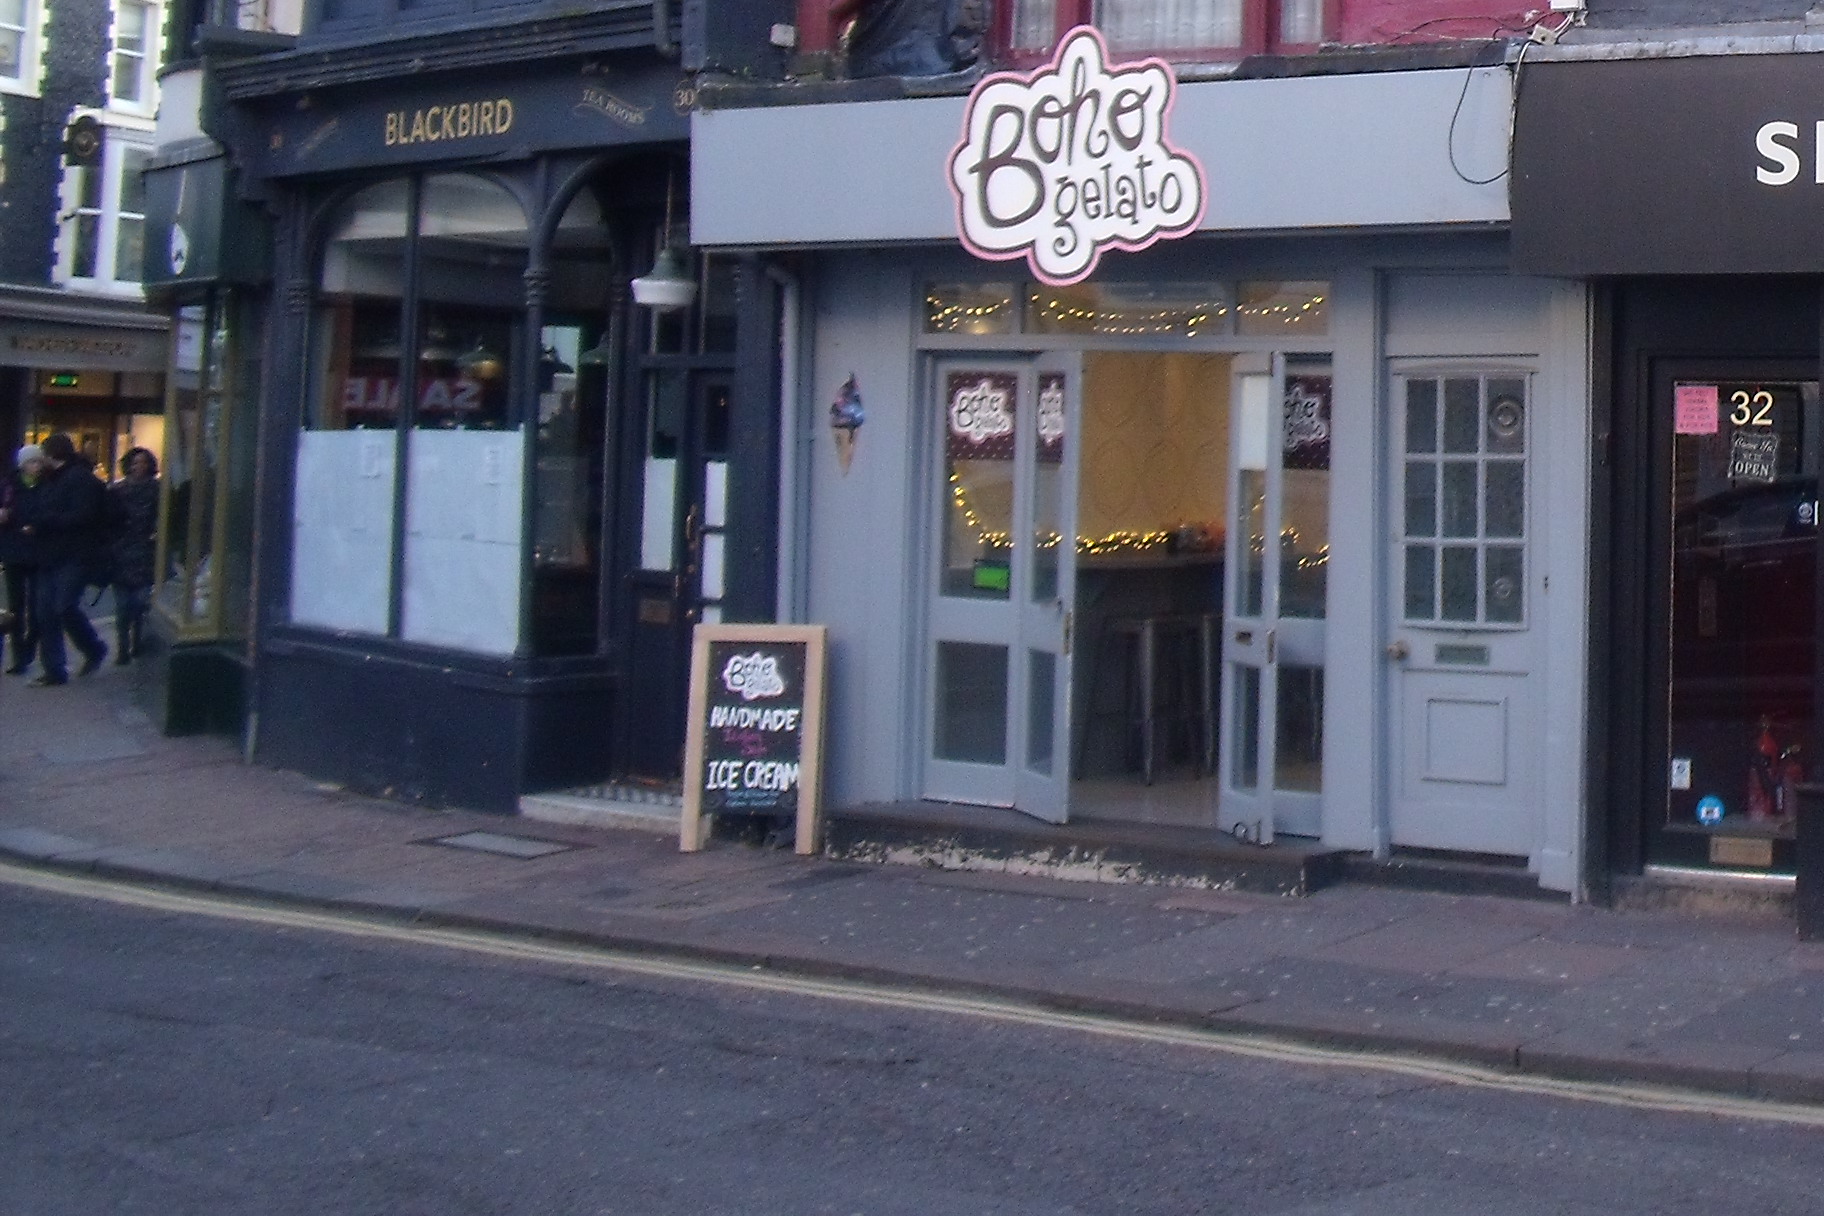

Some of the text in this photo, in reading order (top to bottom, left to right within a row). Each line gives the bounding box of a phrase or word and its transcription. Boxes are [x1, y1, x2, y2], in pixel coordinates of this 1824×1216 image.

[675, 88, 695, 106] 30
[385, 98, 514, 146] BLACKBIRD
[968, 56, 1153, 229] Boho
[1053, 155, 1183, 258] gelato
[1730, 390, 1774, 426] 32
[1735, 461, 1769, 477] OPEN
[710, 705, 799, 732] HANDMADE
[706, 760, 800, 792] ICE CREAM
